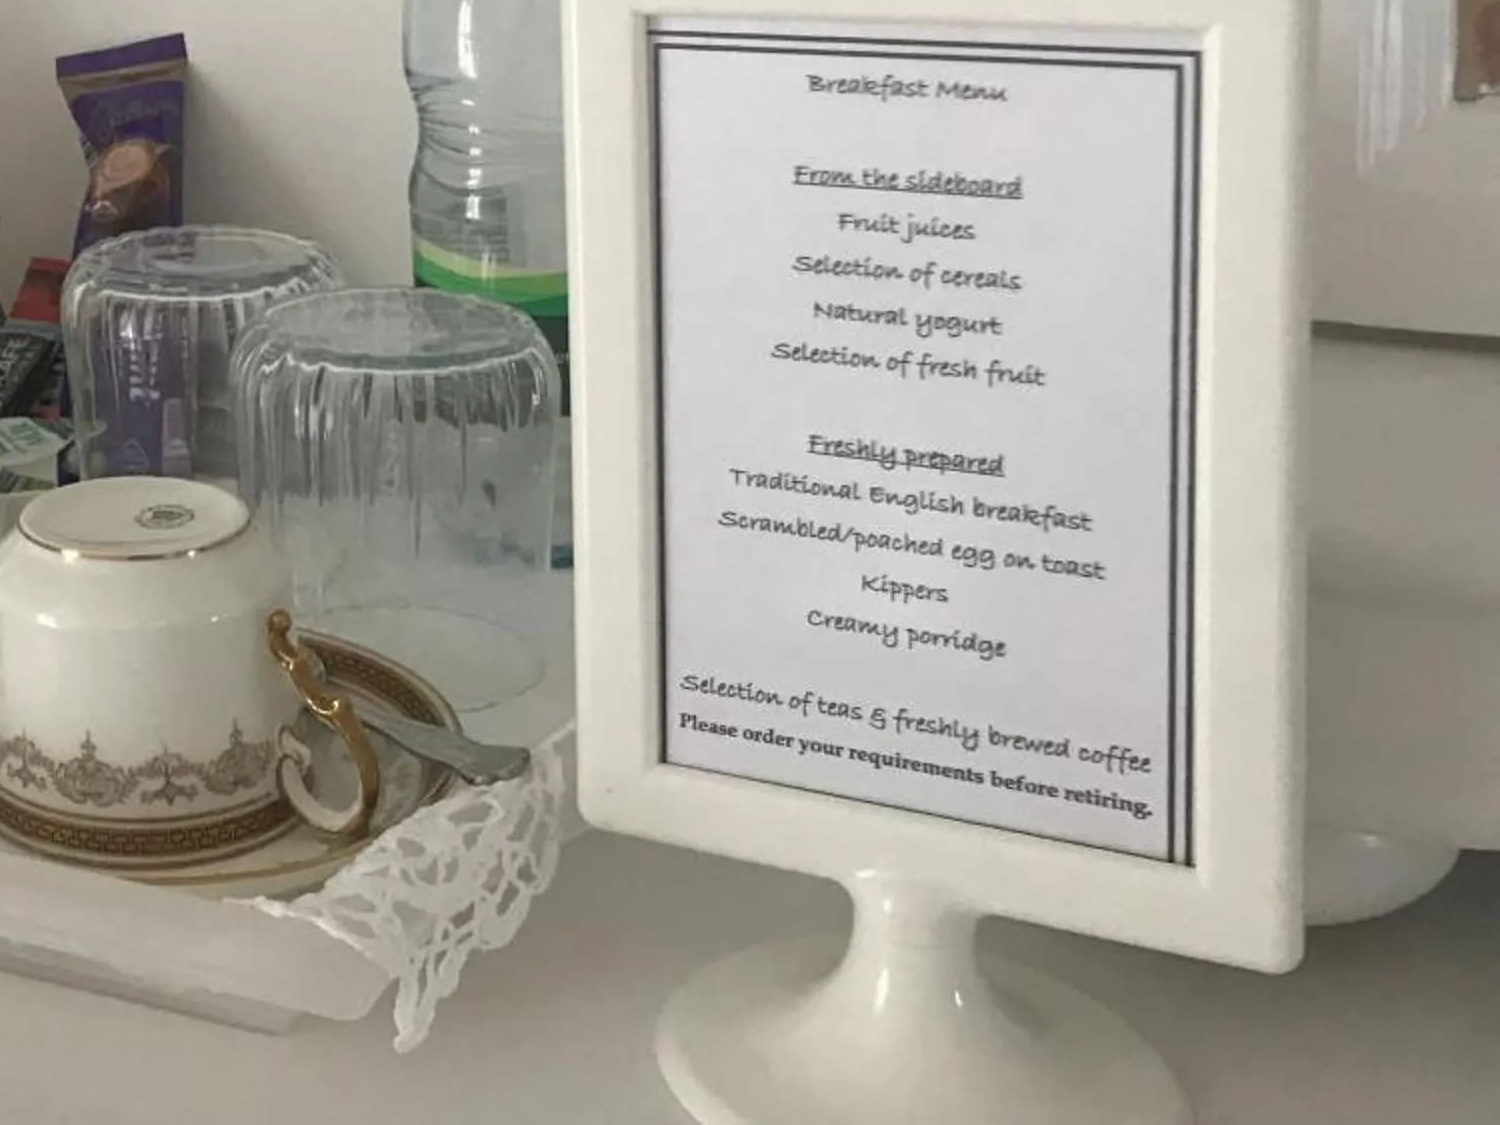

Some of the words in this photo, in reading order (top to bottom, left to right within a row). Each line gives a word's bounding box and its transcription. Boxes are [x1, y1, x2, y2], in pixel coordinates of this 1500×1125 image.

[806, 75, 929, 100] Breakfast
[936, 82, 1008, 102] Menu
[793, 166, 853, 186] From
[861, 169, 900, 191] the
[905, 169, 1023, 198] sideboard
[838, 213, 900, 235] Fruit
[902, 215, 976, 242] juices
[792, 256, 903, 280] Selection
[909, 262, 937, 288] of
[940, 267, 1022, 290] cereals
[813, 302, 908, 326] Natural
[915, 311, 1003, 337] yogurt
[772, 343, 880, 369] Selection
[885, 351, 912, 378] of
[916, 352, 977, 379] fresh
[985, 360, 1046, 387] fruit
[807, 435, 895, 469] Freshly
[903, 446, 1005, 477] prepared
[729, 469, 862, 502] Traditional
[869, 486, 964, 516] English
[974, 496, 1093, 532] breakfast
[718, 511, 943, 556] Scrambled/poached
[951, 544, 996, 570] egg
[1004, 551, 1036, 570] on
[1042, 554, 1106, 580] toast
[861, 575, 949, 603] Kippers
[806, 610, 899, 646] Creamy
[907, 626, 1007, 660] porridge
[680, 675, 783, 708] Selection
[788, 692, 812, 718] of
[818, 697, 863, 721] teas
[893, 708, 980, 750] freshly
[989, 725, 1071, 760] brewed
[1079, 743, 1151, 775] coffee
[679, 712, 738, 739] Please
[742, 725, 794, 751] order
[799, 737, 844, 759] your
[849, 748, 984, 786] requirements
[990, 769, 1058, 798] before
[1065, 784, 1153, 819] retiring.
